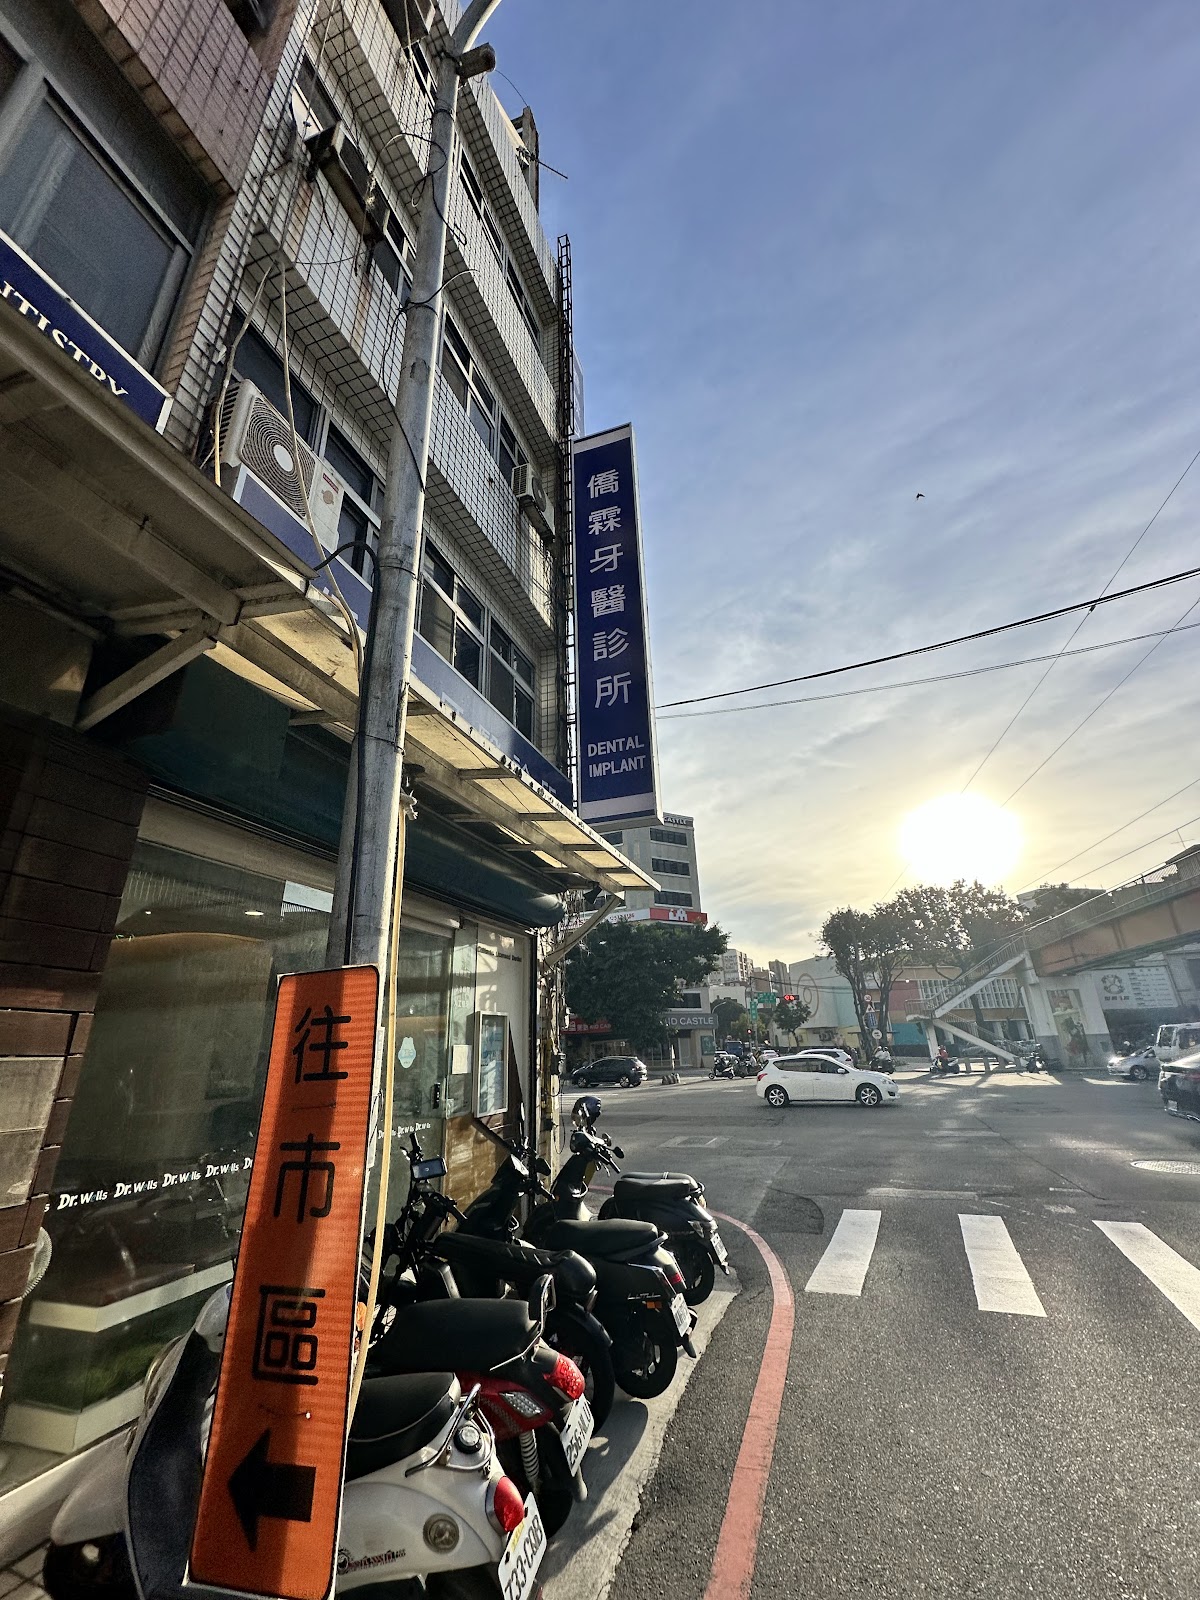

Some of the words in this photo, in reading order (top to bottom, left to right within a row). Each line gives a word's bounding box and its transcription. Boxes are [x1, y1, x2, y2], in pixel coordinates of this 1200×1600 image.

[587, 468, 632, 708] 僑霖牙醫診所
[588, 736, 644, 757] DENTAL
[589, 755, 646, 777] IMPLANT
[679, 1017, 714, 1025] CASTLE
[252, 1005, 350, 1387] 往市區
